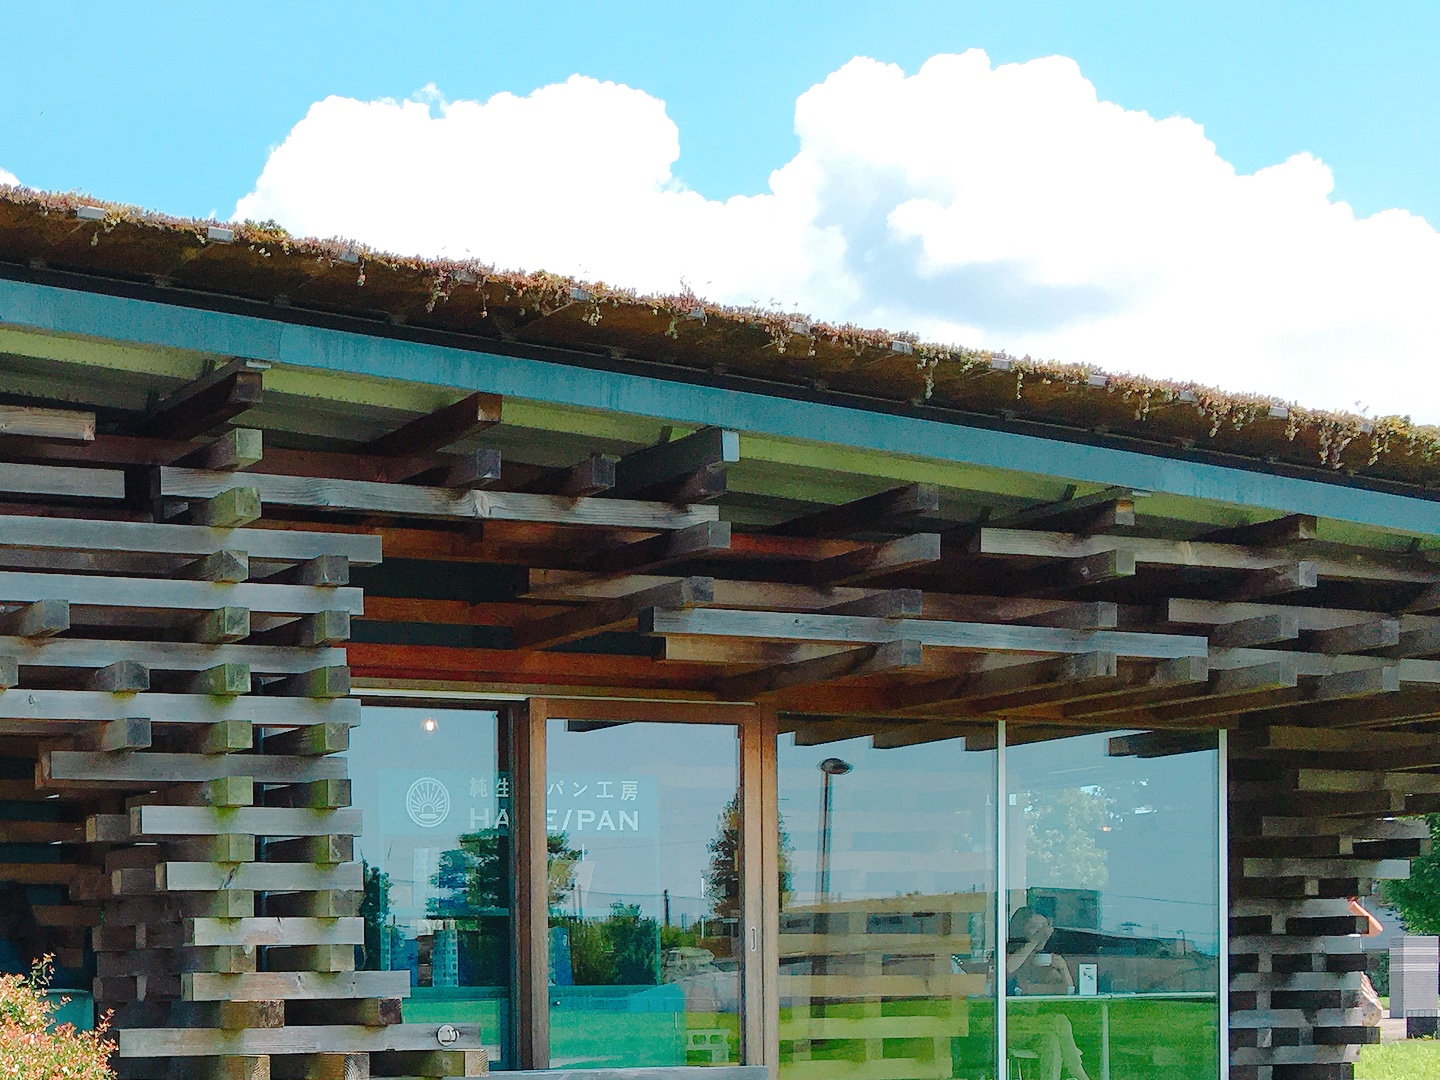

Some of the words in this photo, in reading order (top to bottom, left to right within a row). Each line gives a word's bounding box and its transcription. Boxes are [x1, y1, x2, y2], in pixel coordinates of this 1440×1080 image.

[469, 776, 639, 801] 純生パン工房
[469, 807, 640, 831] HAE/PAN
